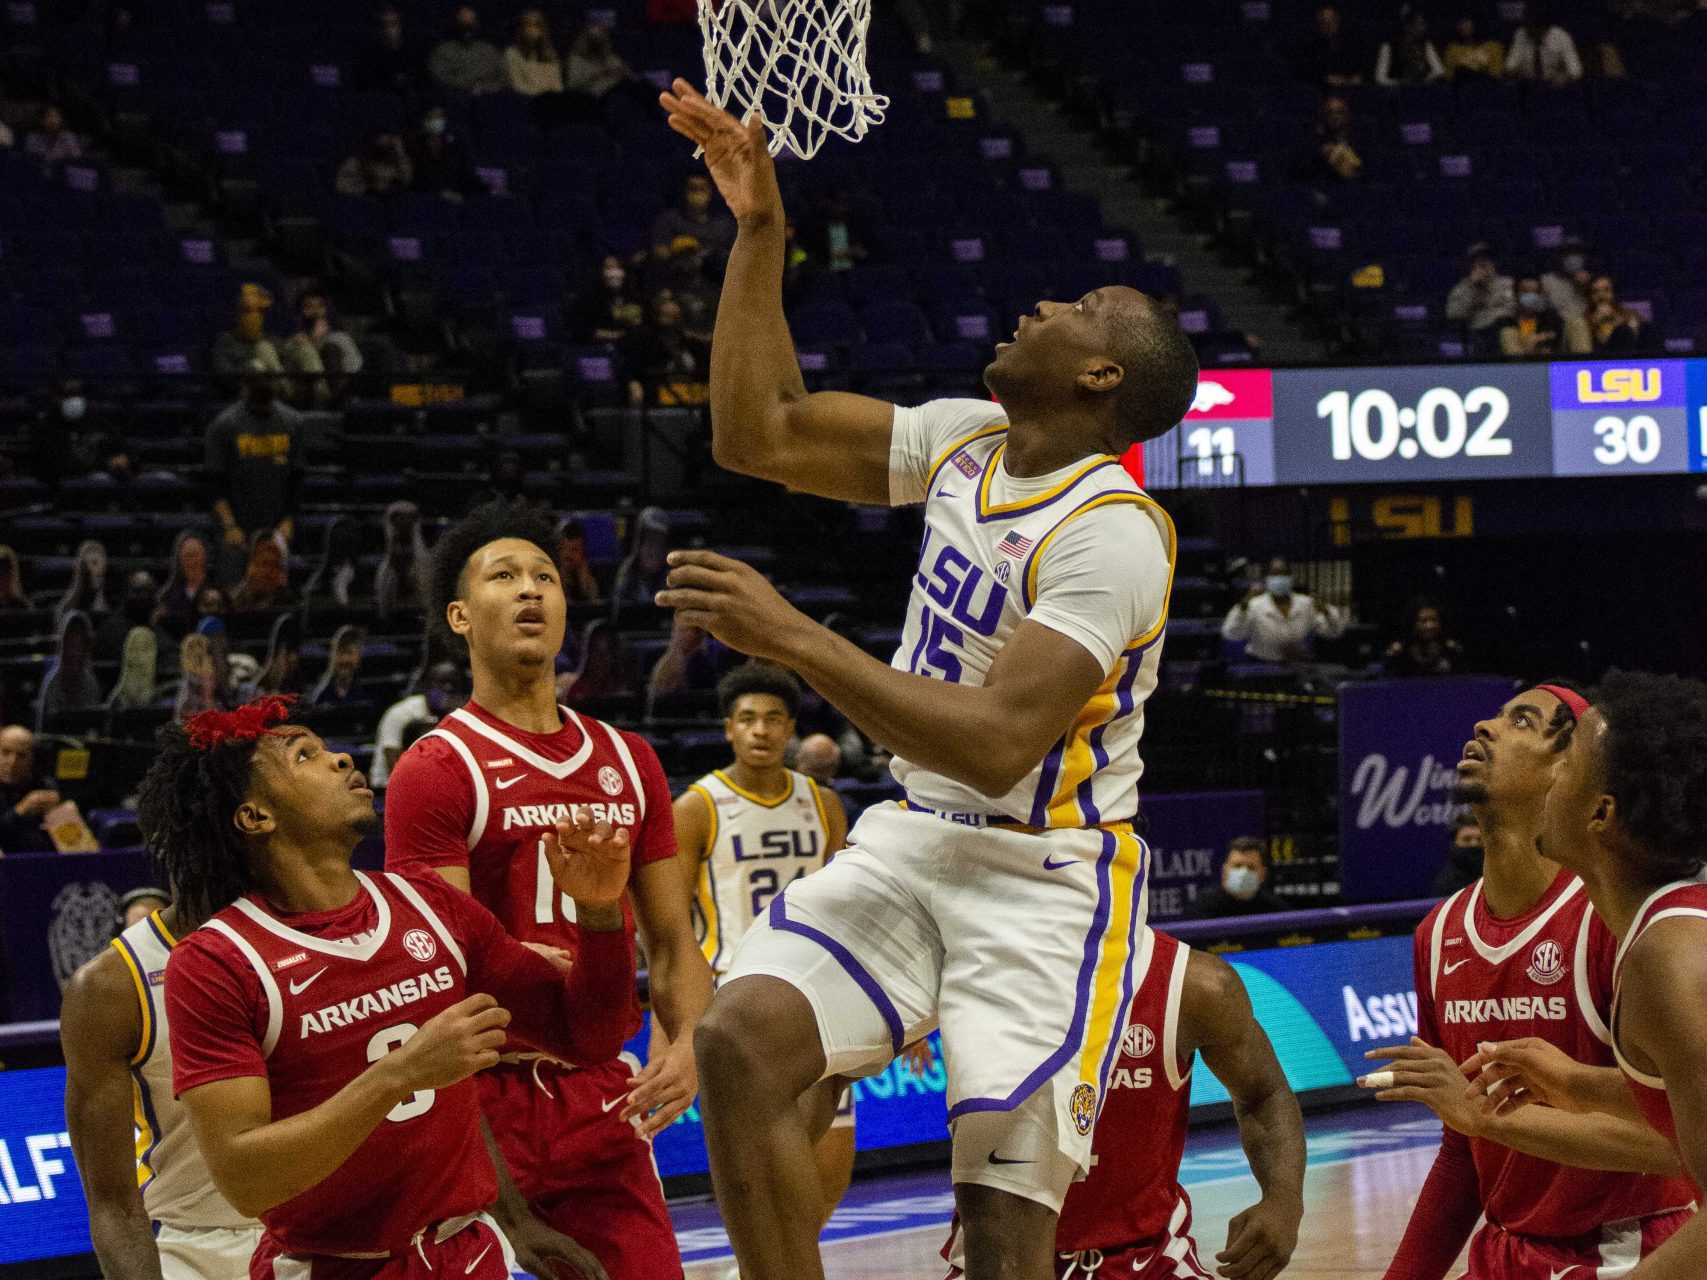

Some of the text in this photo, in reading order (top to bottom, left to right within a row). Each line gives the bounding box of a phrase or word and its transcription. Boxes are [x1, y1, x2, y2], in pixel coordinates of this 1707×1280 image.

[1576, 368, 1662, 403] LSU
[1317, 386, 1513, 460] 10:02
[1593, 415, 1661, 465] 30
[1188, 427, 1235, 476] 11
[918, 526, 1008, 637] LSU
[731, 829, 818, 863] LSU
[1151, 847, 1215, 879] LADY
[749, 866, 806, 917] 2
[404, 929, 435, 961] SEC
[1535, 942, 1561, 972] SEC
[300, 965, 455, 1040] ARKANSAS
[1444, 996, 1567, 1025] ARKANSAS
[1123, 1026, 1153, 1057] SEC
